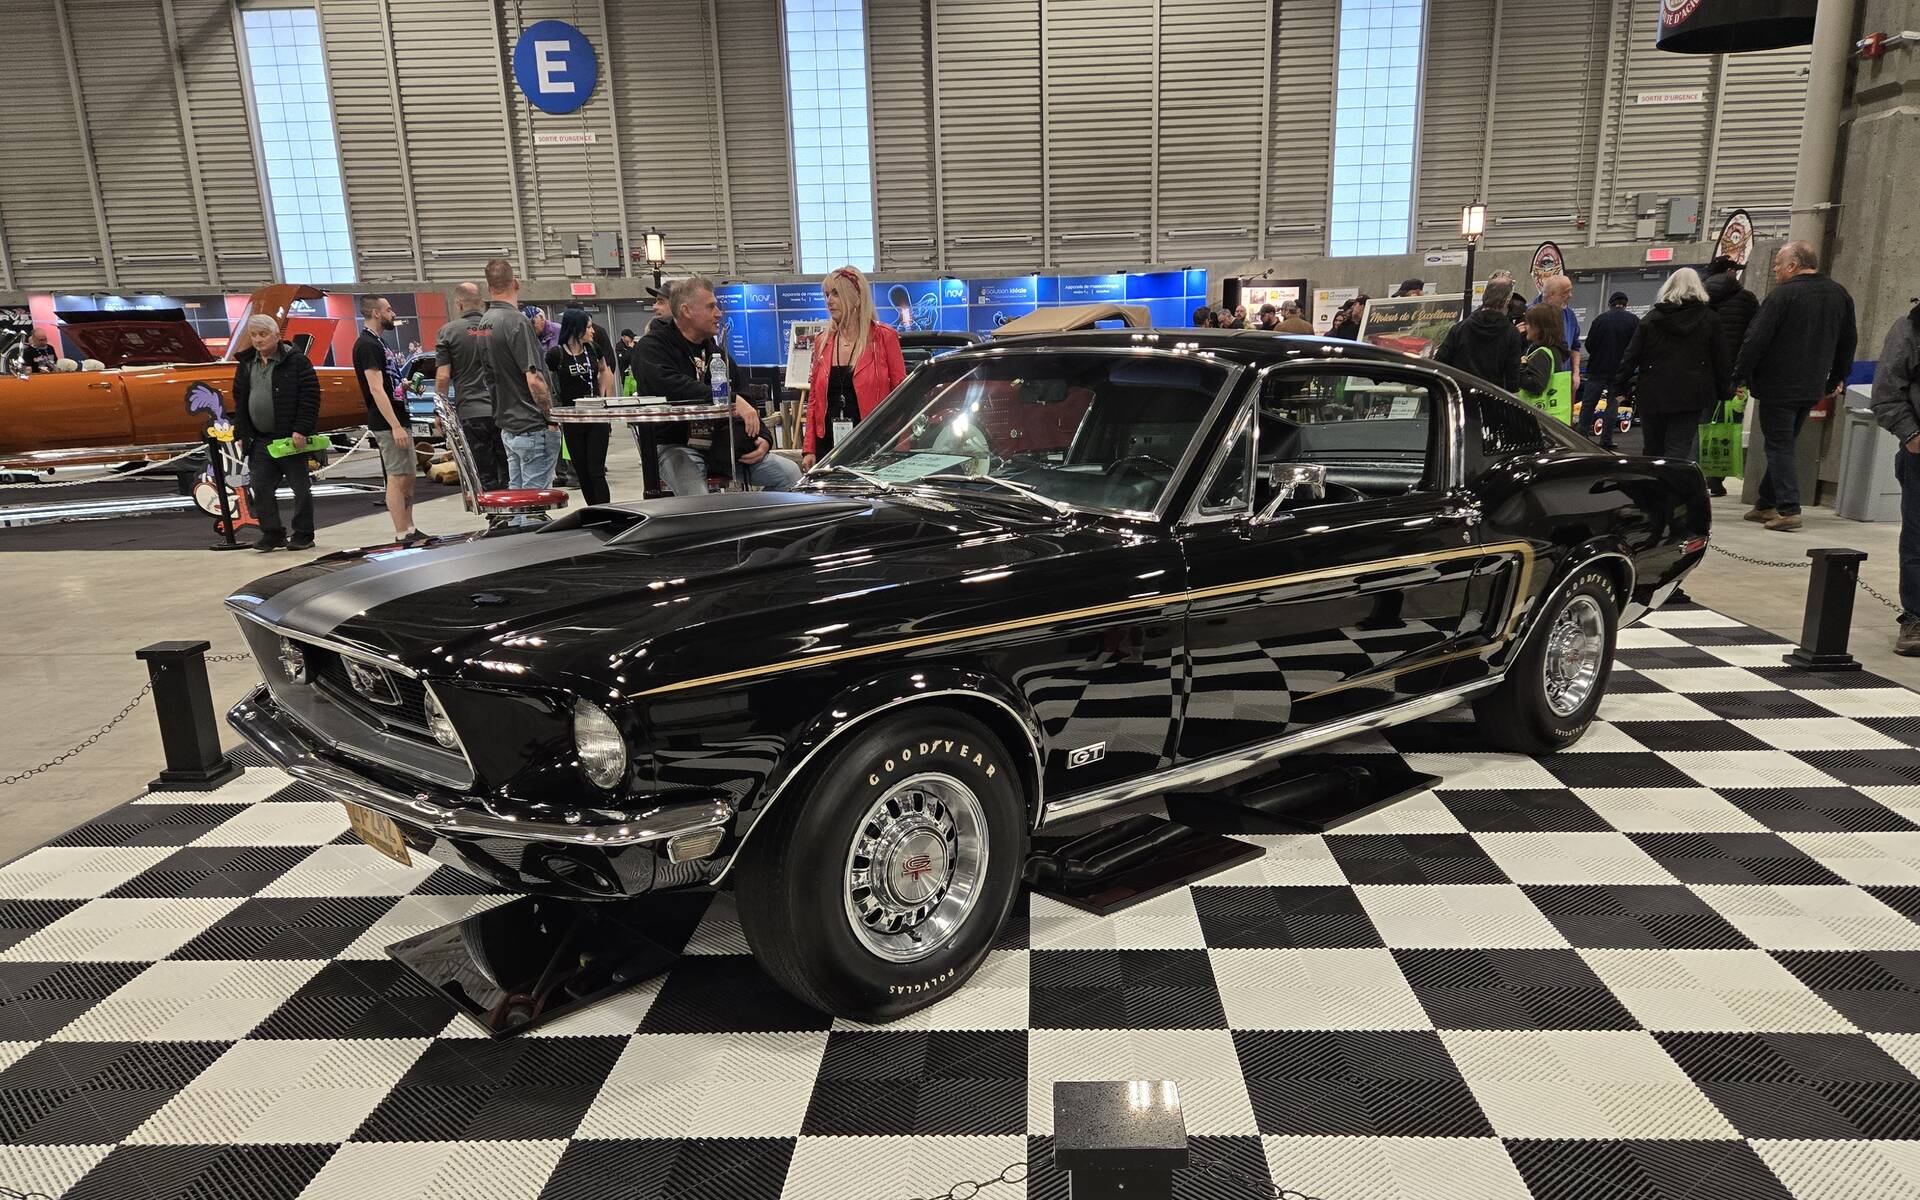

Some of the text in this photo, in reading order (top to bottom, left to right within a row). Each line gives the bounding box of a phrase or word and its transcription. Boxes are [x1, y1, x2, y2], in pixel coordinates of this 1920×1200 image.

[534, 40, 575, 93] E
[1369, 311, 1399, 323] Moteur
[1400, 312, 1410, 320] de
[1566, 574, 1616, 603] GOODYEAR
[869, 740, 996, 786] GOODYEAR
[1073, 745, 1104, 764] GT
[889, 968, 954, 994] POLYGLAS
